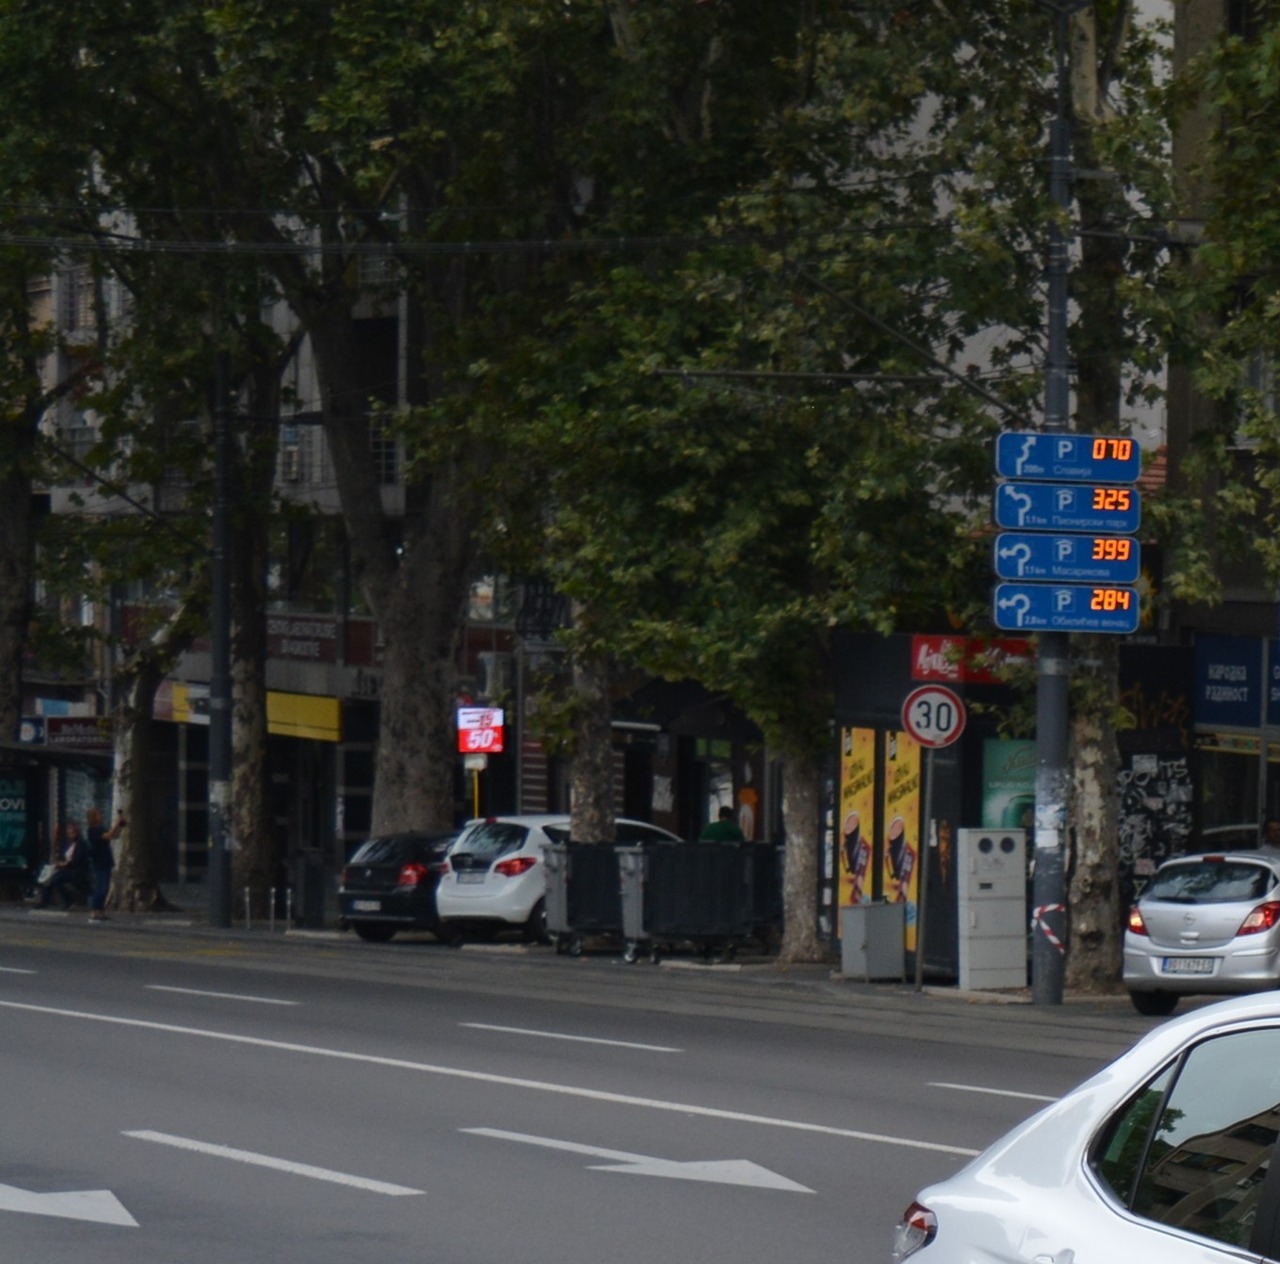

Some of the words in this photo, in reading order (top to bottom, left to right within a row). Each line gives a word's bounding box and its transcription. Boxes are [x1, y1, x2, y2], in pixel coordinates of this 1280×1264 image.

[1092, 439, 1133, 461] 070
[1053, 465, 1092, 477] Славија
[1092, 489, 1131, 511] 325
[1105, 519, 1128, 533] парк
[1092, 539, 1131, 561] 399
[1053, 566, 1110, 578] Масарикова
[1091, 589, 1130, 611] 284
[1052, 615, 1099, 627] Обилићев
[915, 701, 952, 732] 30
